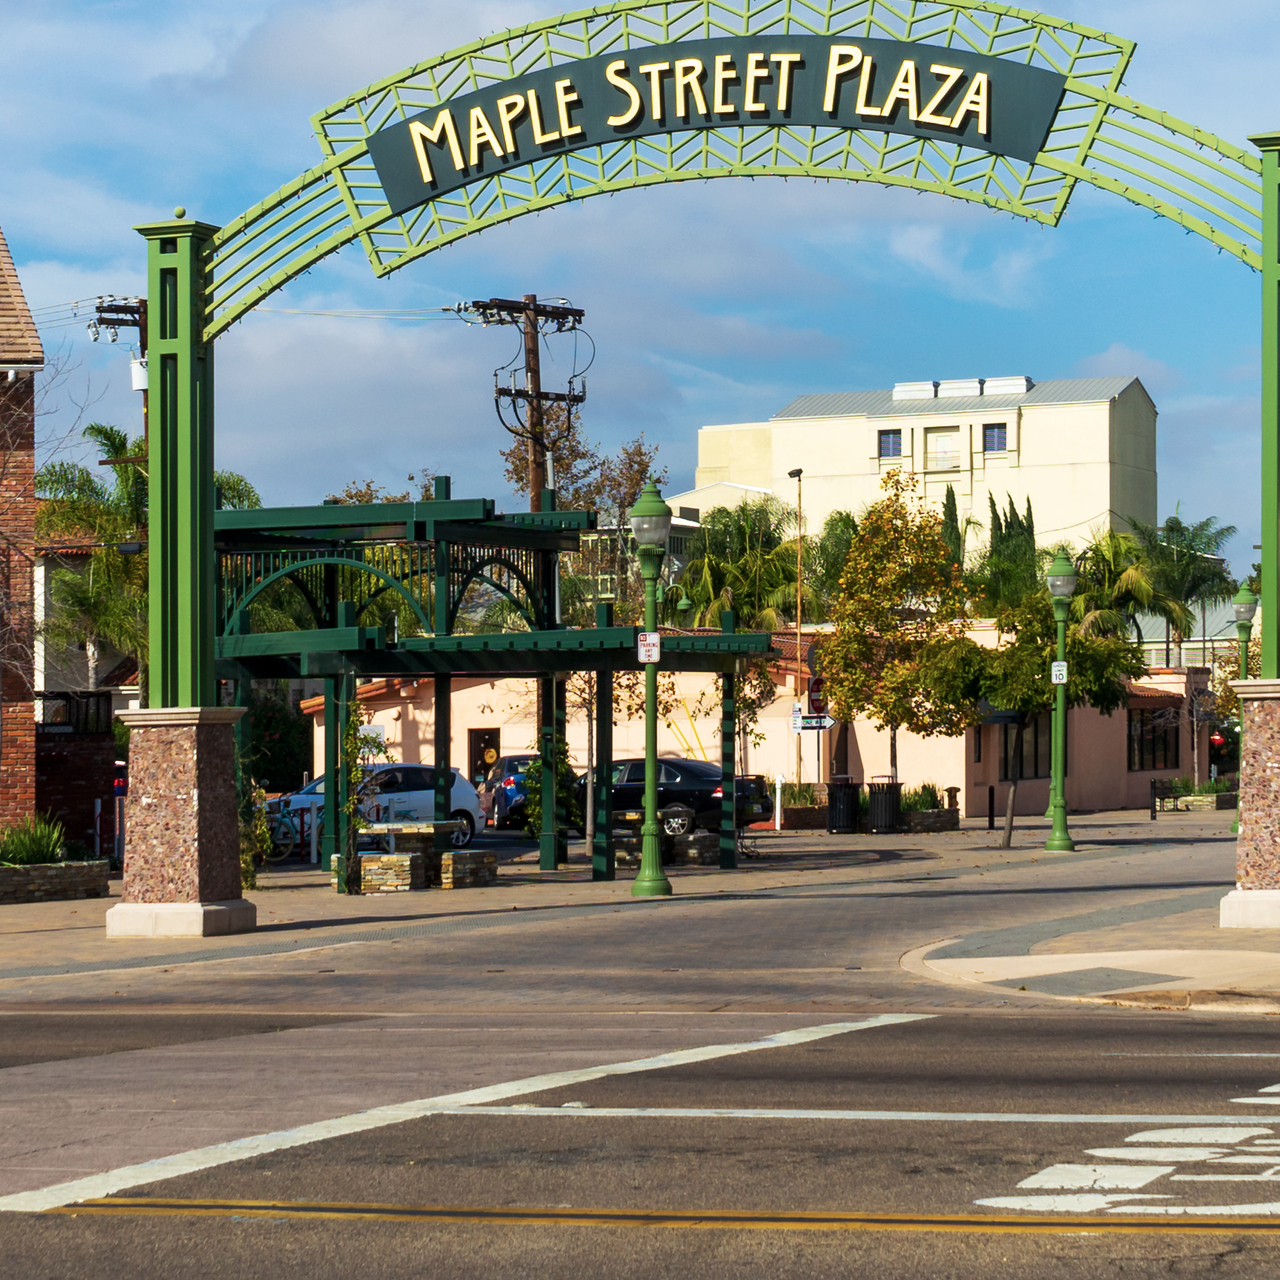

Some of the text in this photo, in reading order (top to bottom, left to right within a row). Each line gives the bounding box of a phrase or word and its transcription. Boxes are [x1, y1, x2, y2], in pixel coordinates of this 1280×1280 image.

[408, 45, 988, 183] MAPLE STREET PLAZA
